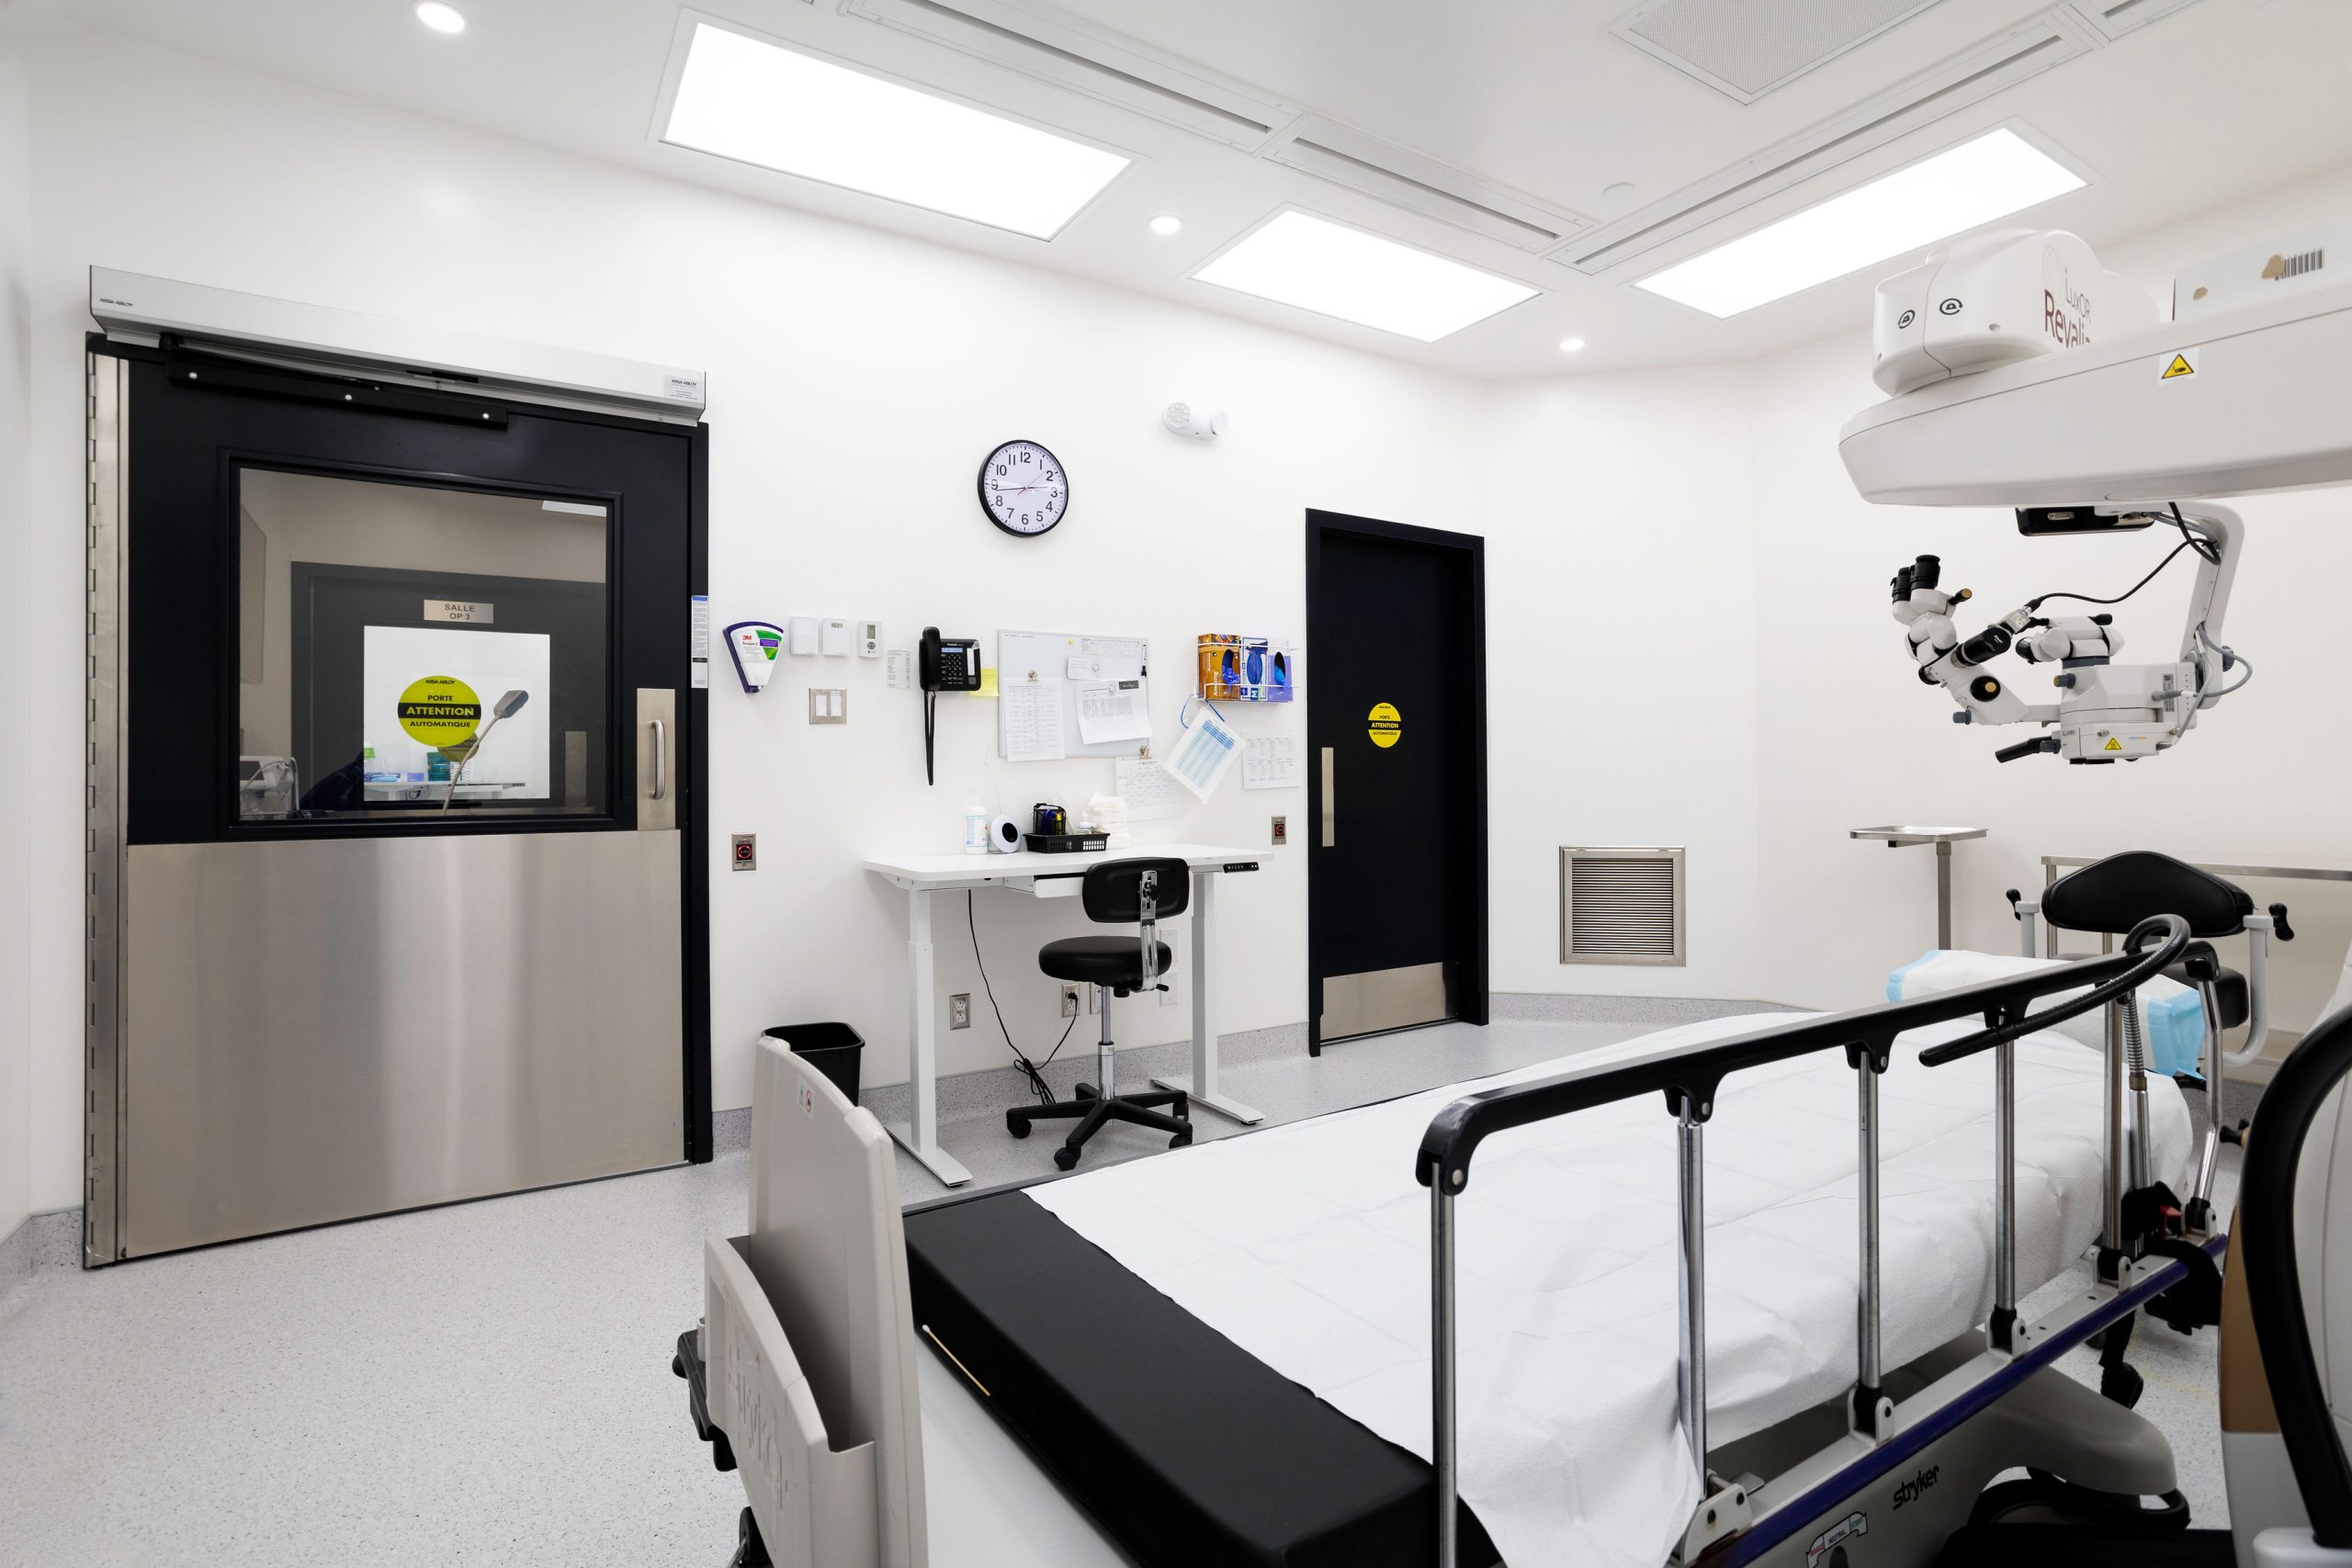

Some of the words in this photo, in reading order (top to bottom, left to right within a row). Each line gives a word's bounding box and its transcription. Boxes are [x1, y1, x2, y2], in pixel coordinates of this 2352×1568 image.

[2044, 288, 2090, 349] Revali
[1009, 454, 1015, 466] 11
[1020, 451, 1031, 463] 12
[996, 465, 1007, 476] 10
[1046, 470, 1054, 481] 2
[991, 479, 999, 491] 9
[1050, 487, 1057, 498] 3
[996, 495, 1003, 506] 8
[1046, 501, 1053, 512] 4
[1007, 507, 1014, 518] 7
[1036, 511, 1044, 522] 5
[1022, 513, 1029, 525] 6
[406, 706, 474, 716] ATTENTION
[1893, 1465, 1939, 1510] stryker
[1828, 1529, 1846, 1543] NEUTRAL
